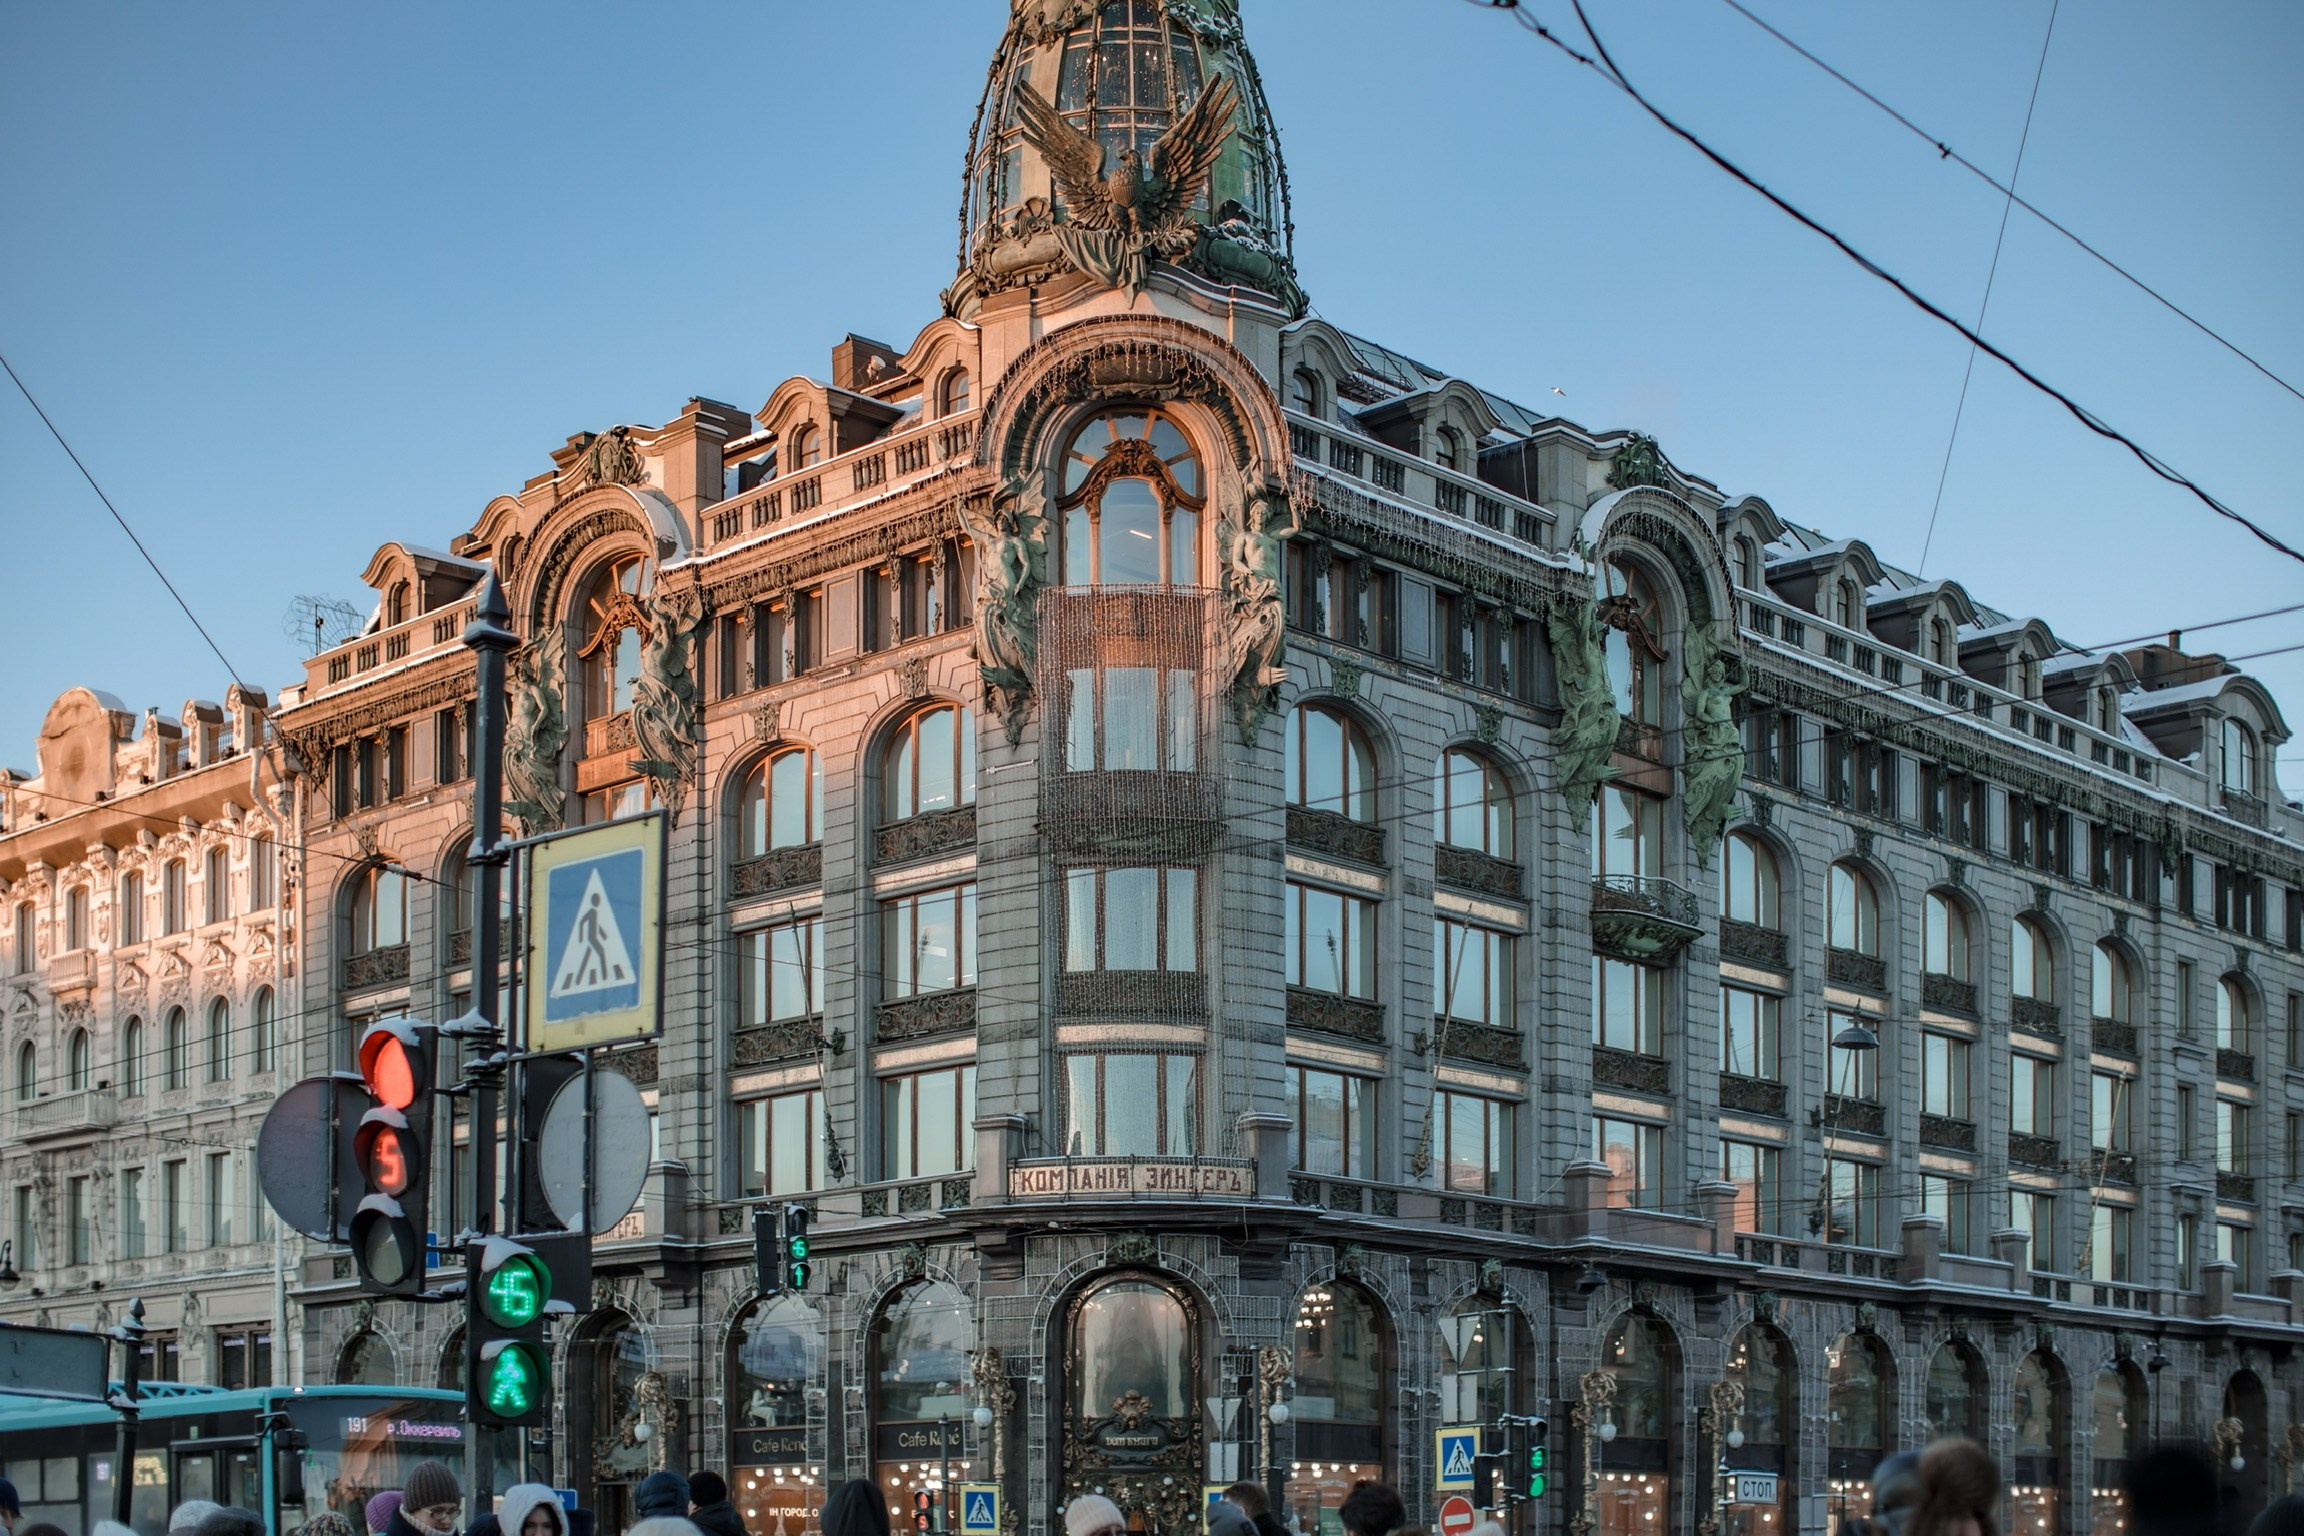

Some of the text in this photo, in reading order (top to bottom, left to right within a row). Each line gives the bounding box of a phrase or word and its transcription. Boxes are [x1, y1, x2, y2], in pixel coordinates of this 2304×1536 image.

[1146, 1166, 1242, 1192] ЗИНГЕРЪ
[347, 1417, 368, 1432] 191
[752, 1438, 779, 1453] Cafe
[898, 1431, 927, 1448] Cafe
[1743, 1481, 1772, 1498] СТОП
